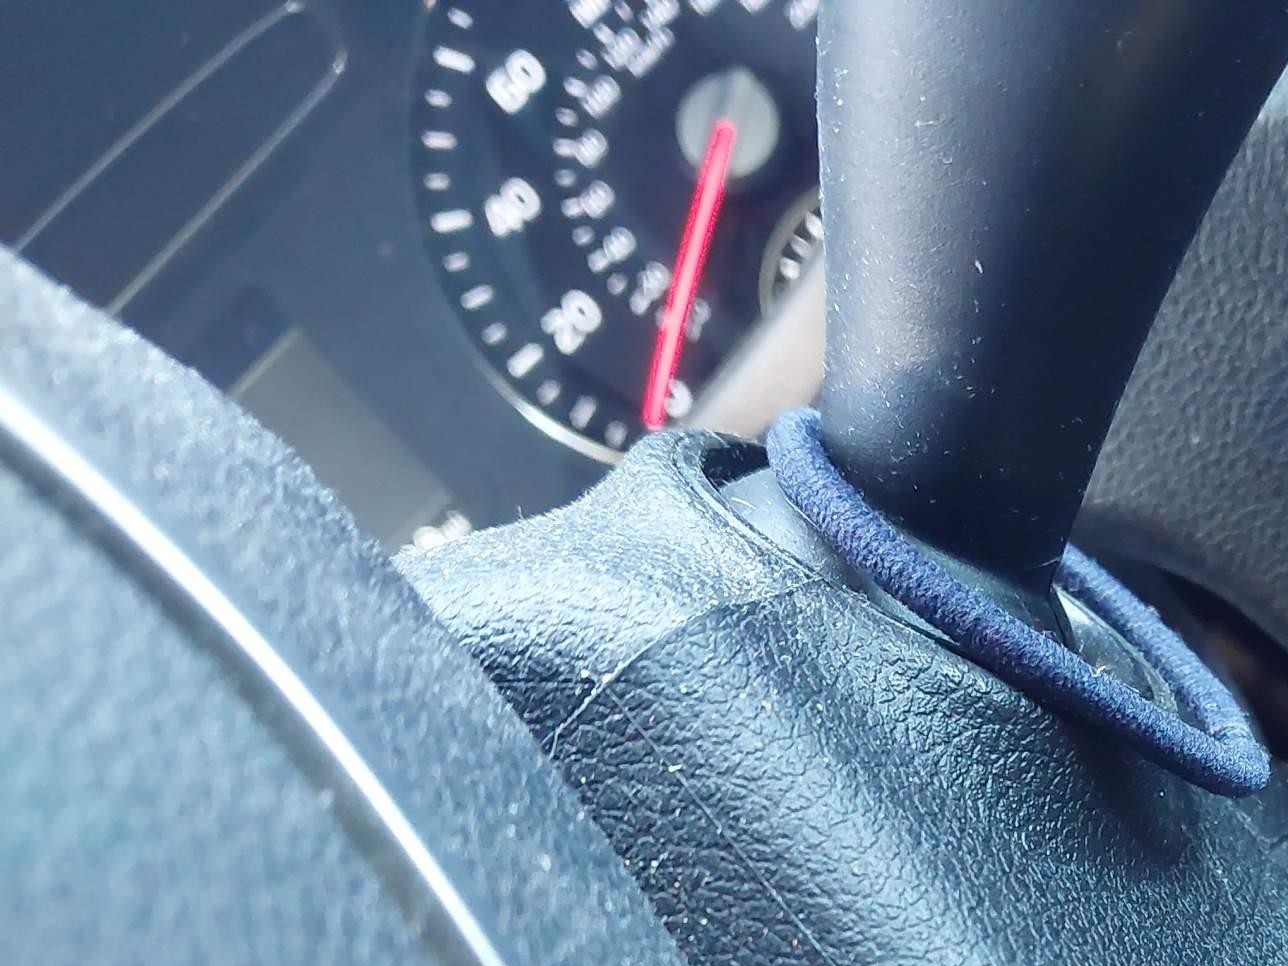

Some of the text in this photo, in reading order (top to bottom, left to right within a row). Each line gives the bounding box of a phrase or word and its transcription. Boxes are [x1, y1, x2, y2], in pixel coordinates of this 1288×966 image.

[486, 49, 546, 114] 60
[484, 177, 541, 236] 40
[540, 289, 602, 355] 20
